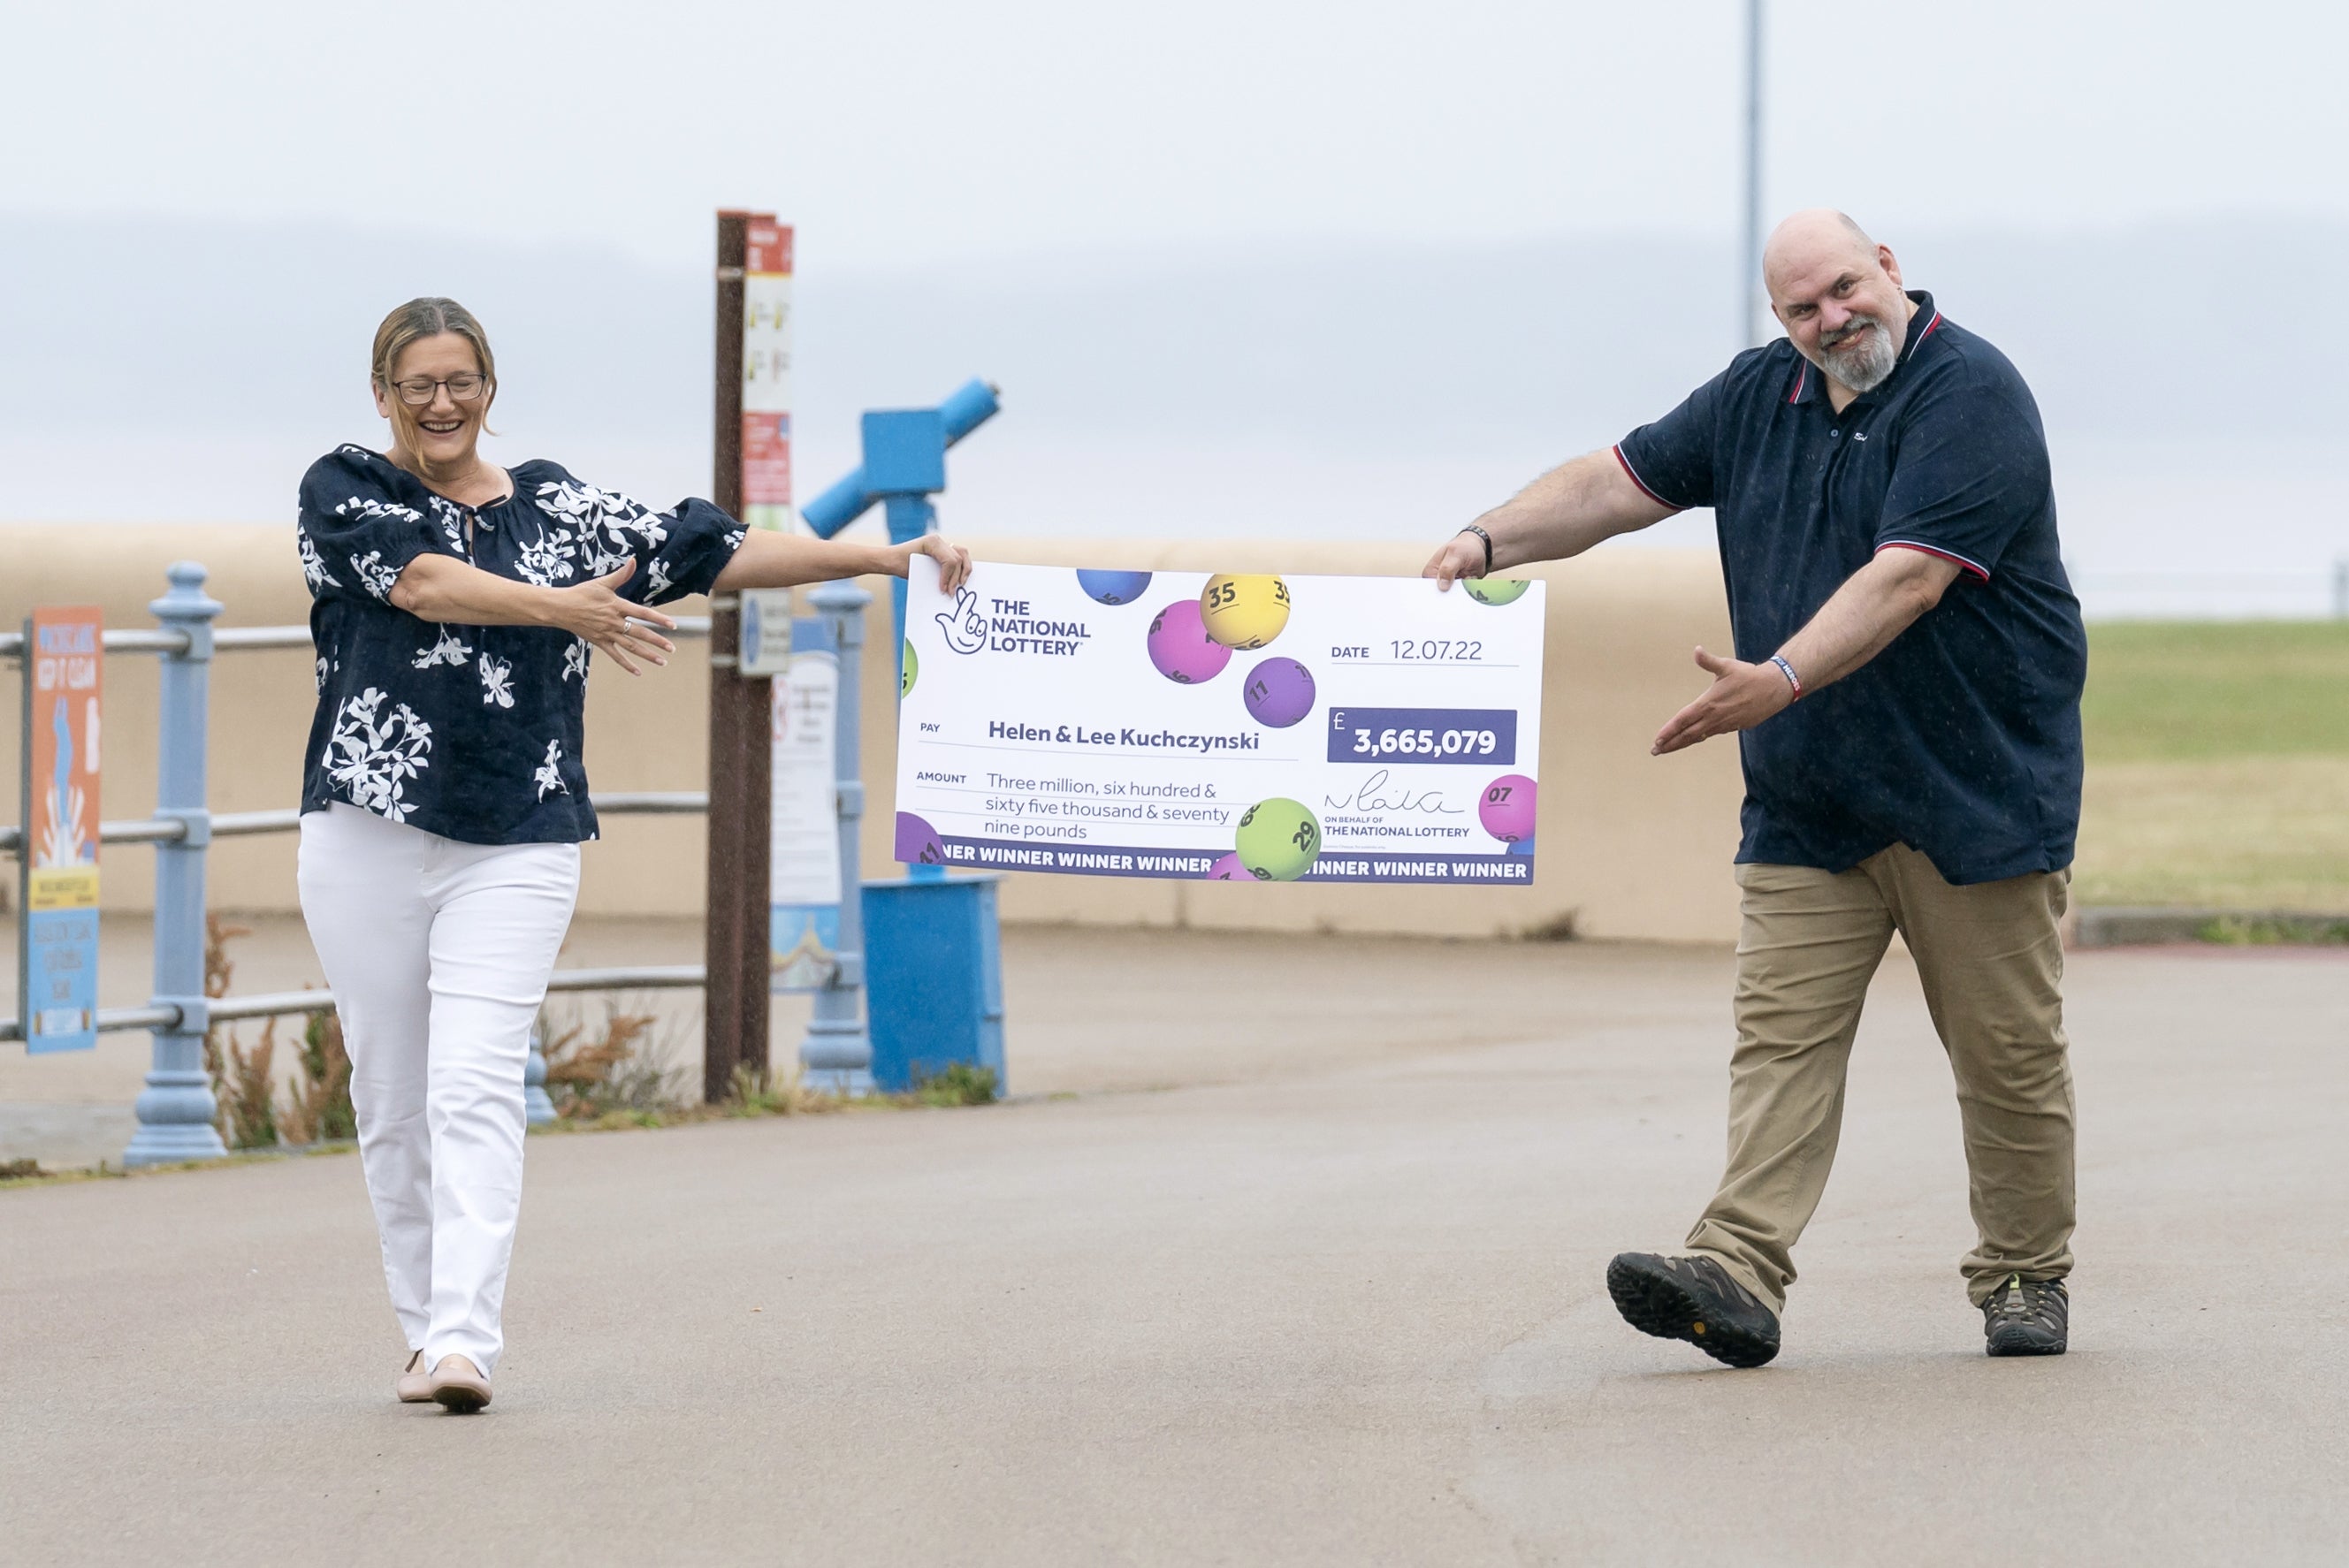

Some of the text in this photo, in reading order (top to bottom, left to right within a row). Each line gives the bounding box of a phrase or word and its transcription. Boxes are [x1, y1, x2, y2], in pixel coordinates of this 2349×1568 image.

[1209, 582, 1236, 608] 35
[991, 599, 1030, 616] THE
[991, 618, 1092, 638] NATIONAL
[991, 637, 1080, 656] LOTTERY
[1331, 641, 1483, 660] DATE 12.07.22
[1249, 680, 1269, 700] 11
[920, 722, 941, 733] PAY
[989, 721, 1260, 753] Helen & Lee Kuchczynski
[1333, 712, 1497, 757] £ 3,665,079
[917, 772, 967, 784] AMOUNT
[987, 773, 1216, 799] Three million, six hundred &
[1488, 787, 1513, 803] 07
[986, 796, 1230, 825] sixty five thousand & seventy
[985, 819, 1088, 839] nine pounds
[1293, 821, 1315, 851] 29
[1324, 826, 1470, 838] THE NATIONAL LOTTERY
[979, 847, 1054, 866] WINNER
[1057, 852, 1133, 871] WINNER
[1137, 856, 1212, 872] WINNER
[1305, 861, 1369, 876] INNER
[1374, 861, 1448, 877] WINNER
[1452, 863, 1527, 879] WINNER
